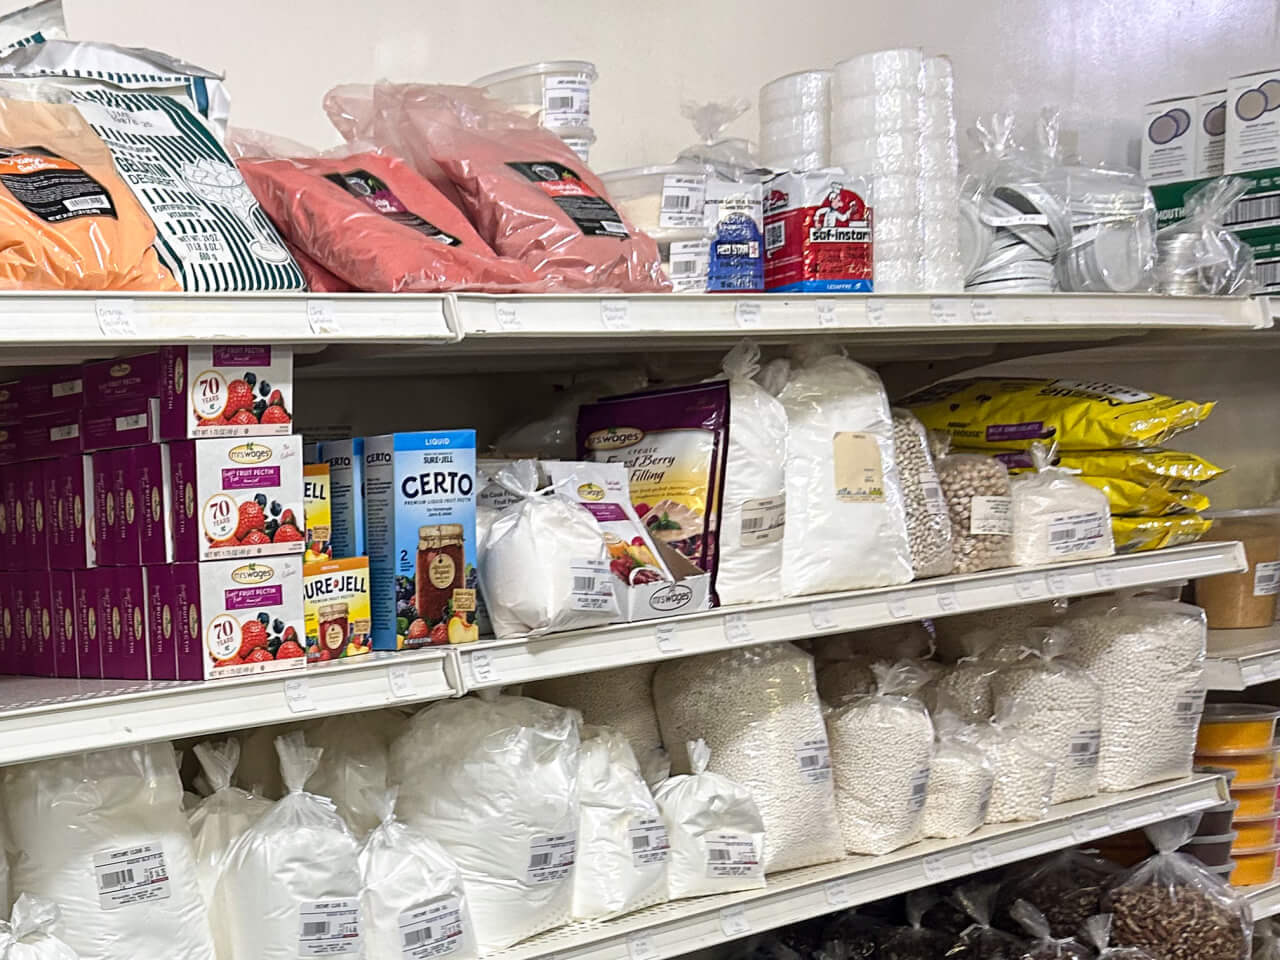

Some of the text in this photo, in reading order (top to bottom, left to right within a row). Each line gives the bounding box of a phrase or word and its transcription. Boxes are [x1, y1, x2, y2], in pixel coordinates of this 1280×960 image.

[200, 377, 220, 397] 70
[425, 437, 450, 446] LIQUID
[366, 453, 391, 464] CERTO
[639, 454, 676, 468] Berry
[630, 469, 665, 484] Filling
[401, 472, 473, 499] CERTO
[209, 500, 230, 520] 70
[400, 550, 408, 561] 2
[303, 577, 333, 600] URE
[213, 620, 233, 640] 70
[216, 637, 234, 645] YEARS
